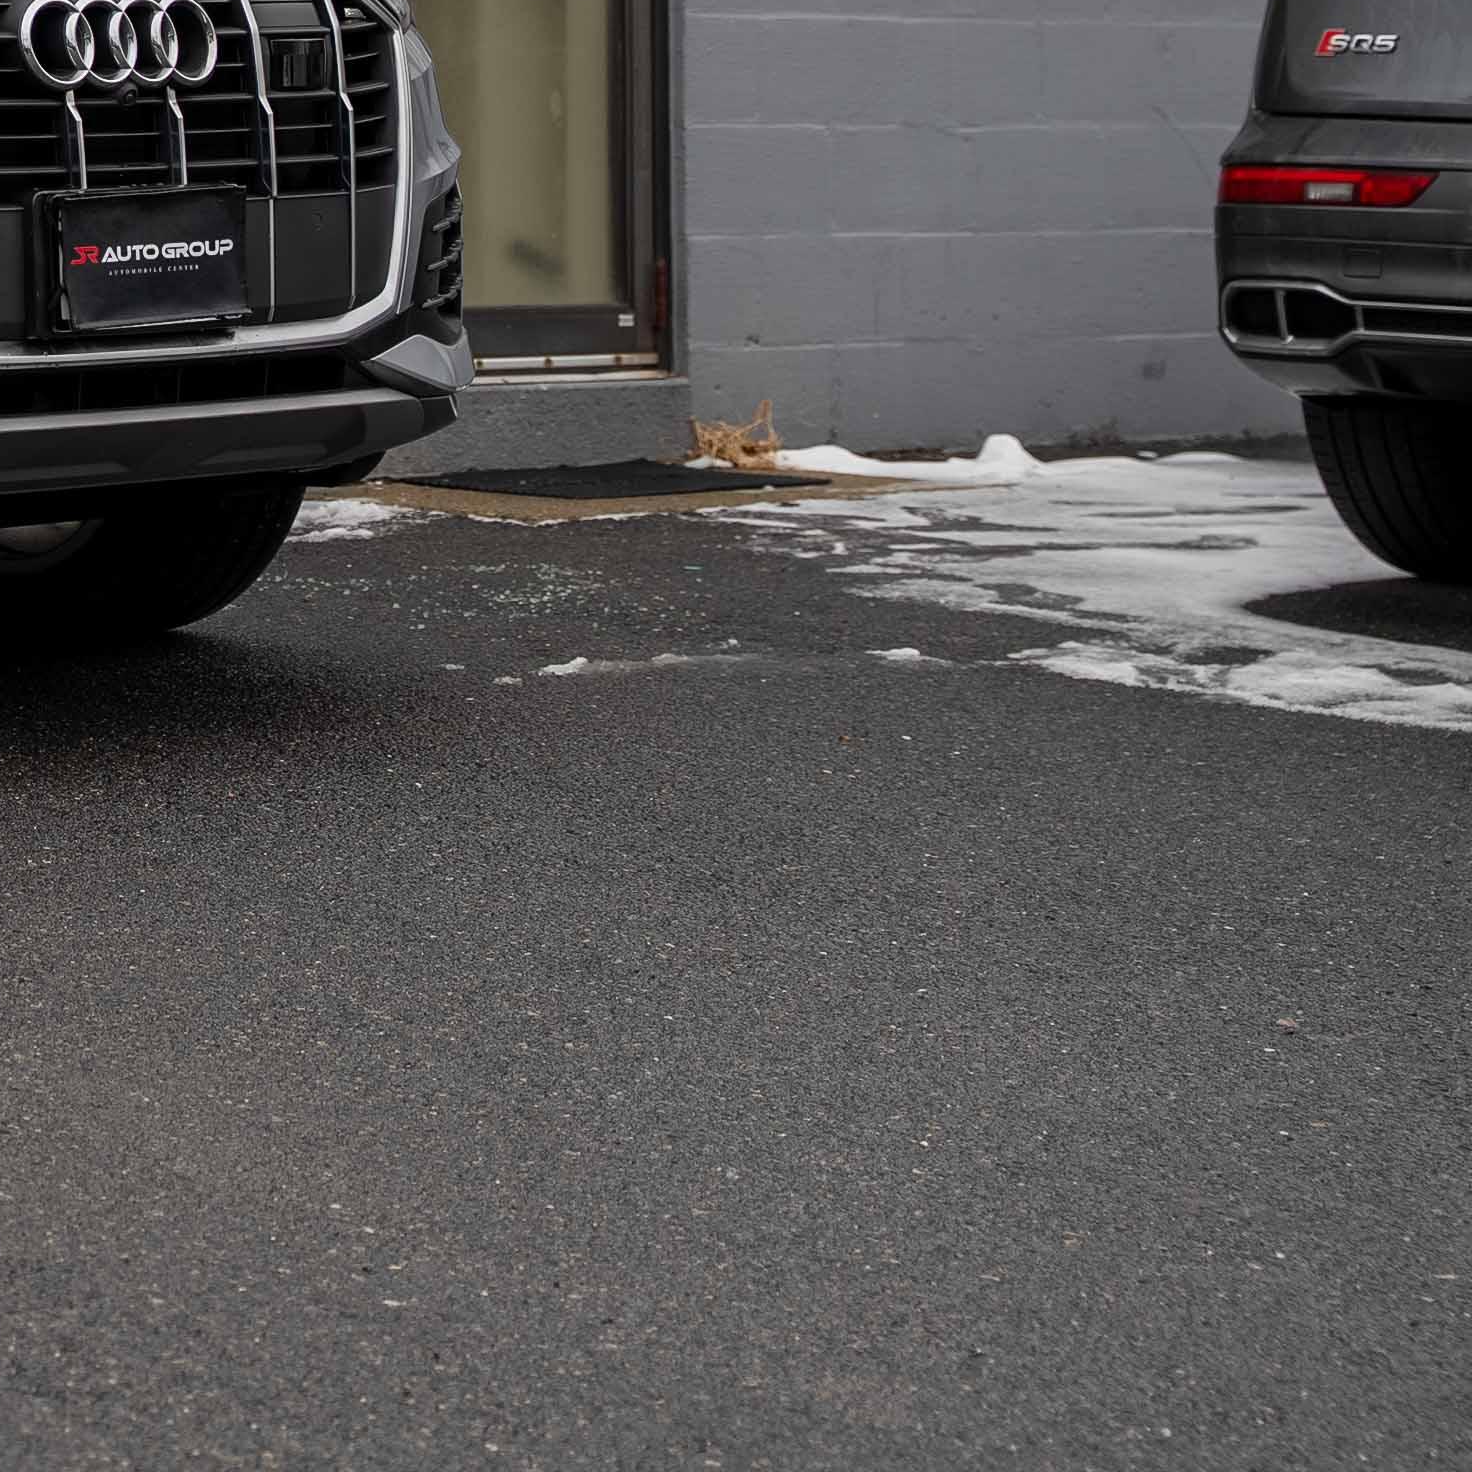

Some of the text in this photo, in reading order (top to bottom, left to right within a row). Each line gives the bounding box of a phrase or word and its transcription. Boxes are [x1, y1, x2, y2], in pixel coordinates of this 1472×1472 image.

[1326, 33, 1399, 53] SQ5
[101, 243, 160, 264] AUTO
[161, 238, 234, 259] GROUP
